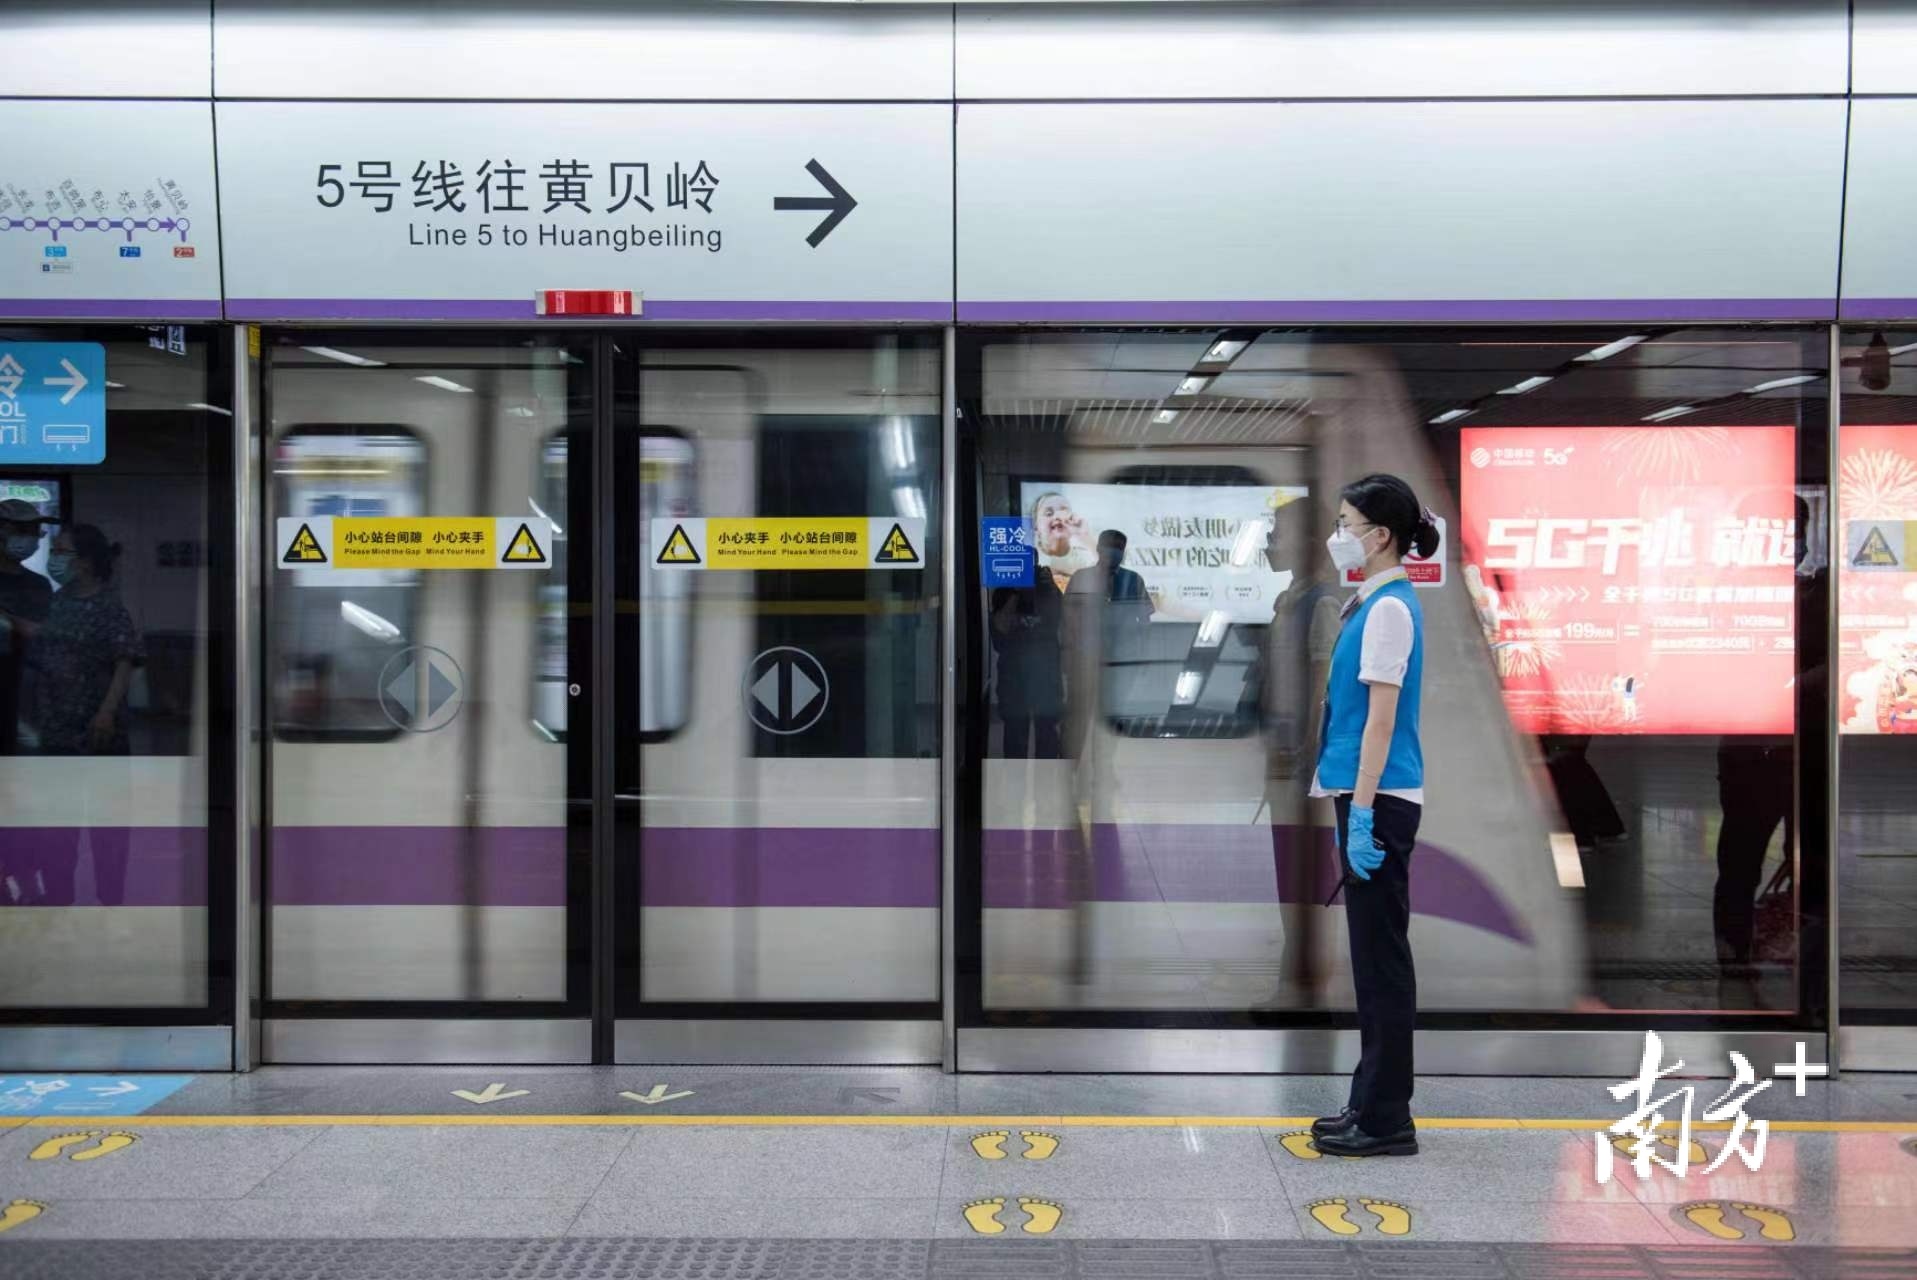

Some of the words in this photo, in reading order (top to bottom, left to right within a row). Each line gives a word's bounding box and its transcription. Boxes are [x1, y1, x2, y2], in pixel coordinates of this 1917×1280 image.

[316, 158, 720, 215] 5号线往黄贝岭
[409, 222, 468, 246] Line
[477, 223, 493, 247] 5
[502, 224, 528, 247] to
[538, 223, 722, 253] Huangbeiling
[344, 531, 423, 544] 小心站台间隙
[432, 531, 485, 544] 小心夹手
[718, 531, 770, 545] 小心夹手
[779, 531, 857, 545] 小心站台间隙
[989, 526, 1026, 545] 强冷
[405, 548, 421, 556] Gap
[717, 548, 737, 556] Mind
[738, 548, 756, 556] Your
[757, 548, 777, 556] Hand
[781, 548, 808, 556] Please
[808, 548, 828, 556] Mind
[828, 548, 841, 556] the
[842, 548, 858, 556] Gap
